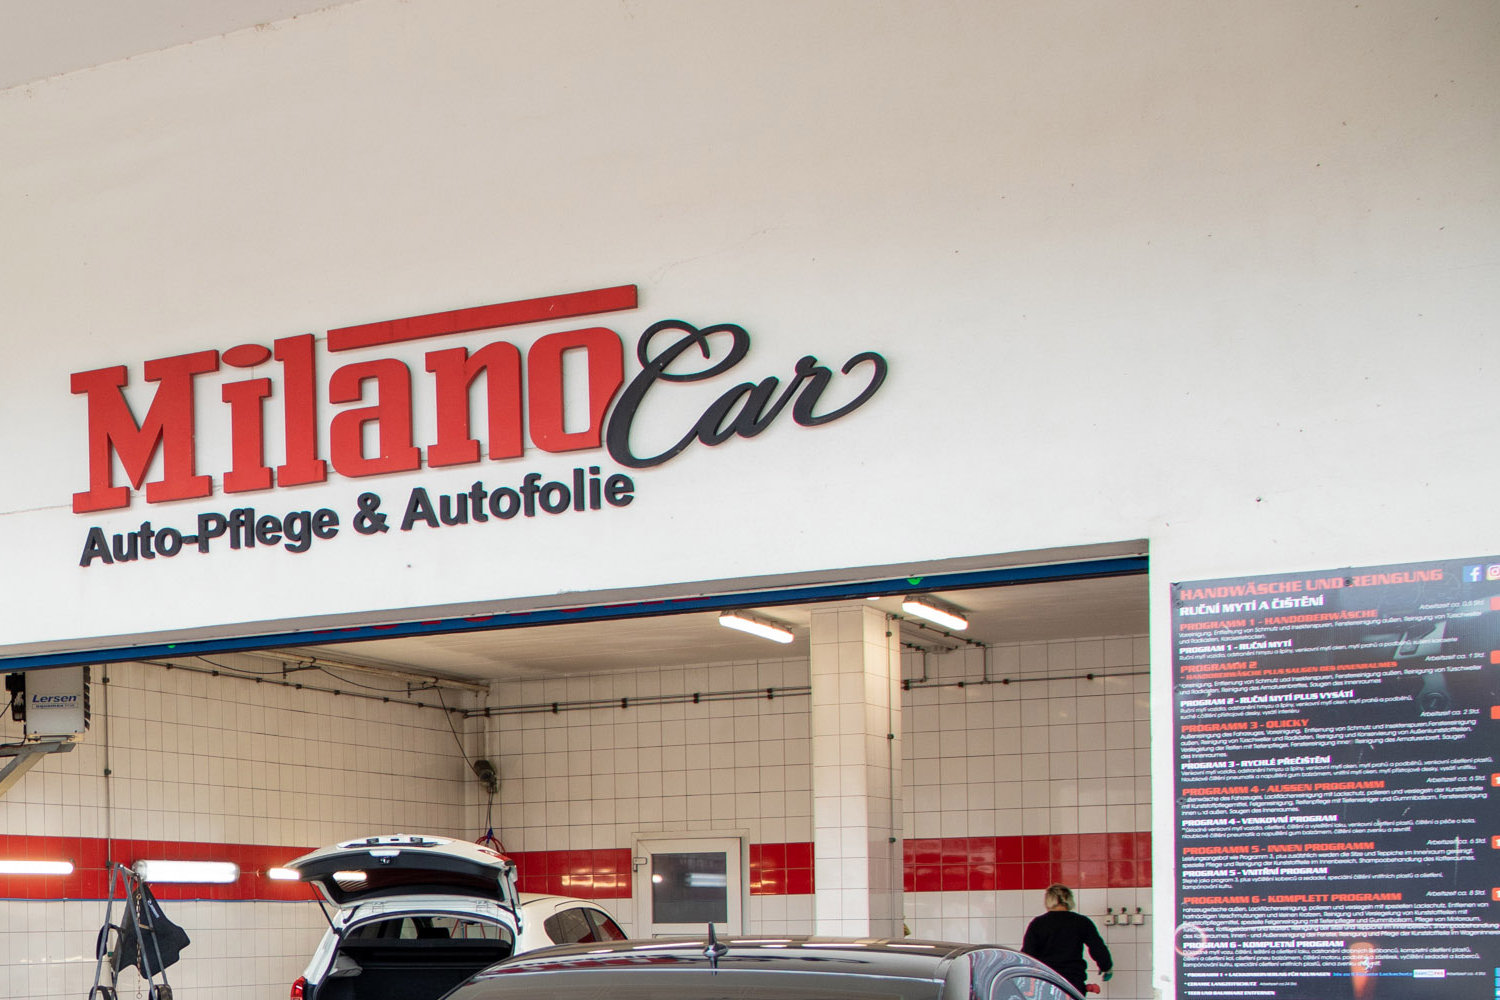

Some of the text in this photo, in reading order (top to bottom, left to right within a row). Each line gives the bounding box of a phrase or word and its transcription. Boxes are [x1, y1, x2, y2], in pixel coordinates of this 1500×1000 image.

[71, 285, 888, 513] Milano Car
[80, 465, 636, 567] Auto-Pflege & Autofolie
[1180, 580, 1302, 601] HANDWÄSCHE
[1306, 576, 1344, 591] UND
[1180, 594, 1324, 617] RUČNÍ MYTÍ A ČIŠTĚNÍ
[1180, 619, 1246, 631] PROGRAMM
[1249, 618, 1255, 626] 1
[1265, 609, 1378, 625] HANDOBERWÄSCHE
[1180, 645, 1225, 654] PROGRAM
[1239, 640, 1267, 650] RUČNÍ
[1268, 639, 1292, 648] MYTÍ
[1180, 661, 1258, 673] PROGRAMM 2
[1263, 668, 1284, 676] PLUS
[32, 694, 77, 703] Lersen
[1180, 698, 1225, 708] PROGRAM
[1240, 694, 1268, 704] RUČNÍ
[1269, 693, 1292, 702] MYTÍ
[1294, 693, 1318, 701] PLUS
[1320, 689, 1354, 699] VYSÁTÍ
[1181, 722, 1248, 733] PROGRAMM
[1266, 719, 1309, 728] QUICKY
[1181, 762, 1227, 770] PROGRAM
[1241, 758, 1276, 767] RYCHLÉ
[1277, 755, 1331, 765] PŘEČIŠTĚNÍ
[1182, 786, 1249, 796] PROGRAMM
[1267, 783, 1313, 792] AUSSEN
[1315, 780, 1385, 790] PROGRAMM
[1182, 819, 1227, 827] PROGRAM
[1242, 815, 1288, 824] VENKOVNÍ
[1290, 815, 1338, 823] PROGRAM
[1183, 846, 1249, 855] PROGRAMM
[1251, 845, 1260, 853] 5
[1268, 844, 1302, 852] INNEN
[1305, 841, 1374, 851] PROGRAMM
[1242, 867, 1279, 876] VNITŘNÍ
[1280, 867, 1328, 875] PROGRAM
[1184, 896, 1249, 905] PROGRAMM
[1268, 894, 1329, 903] KOMPLETT
[1331, 892, 1402, 901] PROGRAMM
[1243, 940, 1294, 948] KOMPLETNÍ
